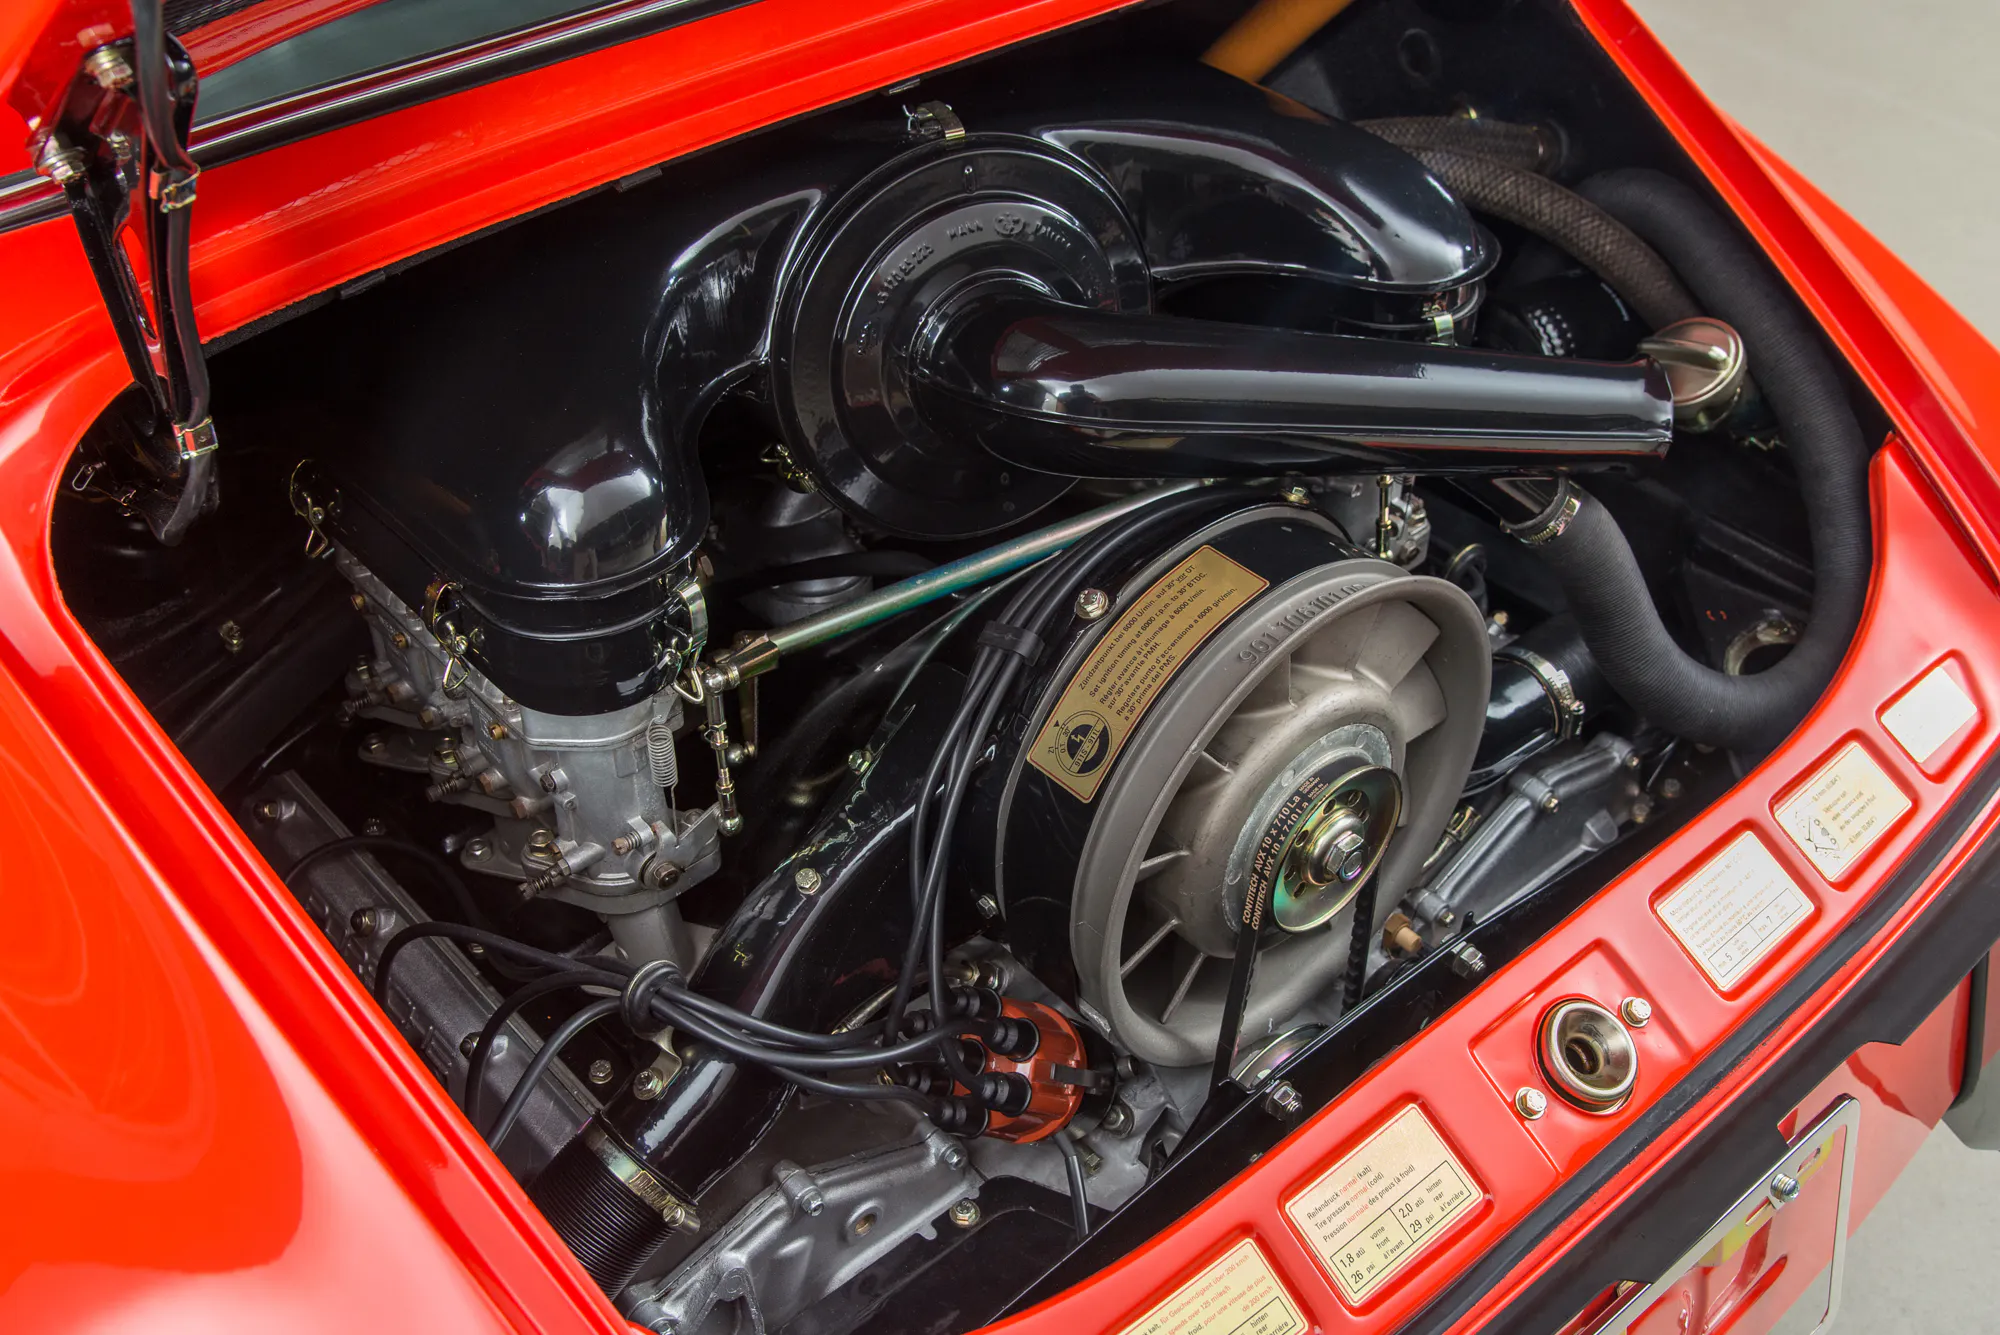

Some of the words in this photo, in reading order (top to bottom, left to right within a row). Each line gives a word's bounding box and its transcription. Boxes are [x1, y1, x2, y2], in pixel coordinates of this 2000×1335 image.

[1079, 643, 1117, 691] Zündzeitpunkt
[1114, 631, 1125, 643] bei
[1123, 616, 1138, 632] 6000
[1156, 588, 1167, 599] auf
[1165, 580, 1175, 590] 30°
[1089, 684, 1101, 698] Set
[1100, 658, 1120, 683] ignition
[1118, 639, 1137, 659] timing
[1135, 630, 1144, 639] at
[1141, 616, 1156, 631] 6000
[1155, 601, 1172, 617] r.p.m.
[1179, 585, 1187, 596] 30°
[1186, 572, 1208, 588] BTDC.
[1100, 681, 1118, 704] Régler
[1117, 655, 1138, 681] avance
[1140, 619, 1170, 652] l'allumage
[1173, 601, 1189, 615] 6000
[1116, 684, 1141, 717] Regolare
[1139, 664, 1157, 685] punto
[1155, 623, 1195, 665] d'accensione
[1197, 605, 1213, 620] 6000
[1212, 587, 1238, 608] giri/min.
[1239, 632, 1280, 665] 901
[1107, 697, 1117, 710] sur
[1115, 683, 1124, 697] 30°
[1124, 665, 1141, 686] avant
[1138, 659, 1146, 667] le
[1143, 642, 1162, 660] PMH.
[1127, 701, 1136, 715] 30°
[1136, 684, 1153, 704] prima
[1151, 671, 1162, 683] del
[1159, 654, 1178, 672] PMS.
[1074, 748, 1088, 767] 911S
[1088, 729, 1101, 744] 911L
[1242, 873, 1260, 924] CONTITECH
[1254, 849, 1267, 873] AVX
[1262, 836, 1272, 849] 10
[1273, 807, 1290, 828] 710
[1286, 795, 1301, 808] La
[1251, 880, 1268, 931] CONTITECH
[1264, 856, 1275, 878] AVX
[1271, 842, 1281, 855] 10
[1282, 813, 1299, 835] 710
[1725, 952, 1733, 961] 5
[1307, 1191, 1341, 1221] Reifendruck
[1339, 1177, 1358, 1196] normal
[1356, 1165, 1372, 1180] (kalt)
[1315, 1218, 1328, 1231] Tire
[1327, 1200, 1351, 1223] pressure
[1350, 1185, 1369, 1203] normal
[1367, 1172, 1385, 1188] (cold)
[1322, 1220, 1348, 1243] Pression
[1347, 1203, 1369, 1225] normale
[1368, 1195, 1379, 1206] des
[1379, 1182, 1396, 1199] pneus
[1399, 1164, 1416, 1181] froid)
[1398, 1202, 1414, 1219] 2,0
[1414, 1197, 1425, 1208] atü
[1426, 1178, 1442, 1194] hinten
[1433, 1191, 1445, 1203] rear
[1376, 1236, 1391, 1249] front
[1409, 1219, 1423, 1233] 29
[1425, 1213, 1435, 1225] psi
[1339, 1253, 1355, 1268] 1,8
[1355, 1247, 1366, 1259] atü
[1370, 1226, 1386, 1240] vorne
[1350, 1270, 1364, 1284] 26
[1366, 1262, 1376, 1274] psi
[1148, 1323, 1162, 1335] kalt,
[1225, 1264, 1236, 1275] 200
[1168, 1318, 1189, 1335] speeds
[1188, 1308, 1201, 1320] over
[1200, 1299, 1212, 1310] 125
[1204, 1313, 1217, 1326] pour
[1217, 1305, 1228, 1315] une
[1228, 1291, 1247, 1306] vitesse
[1247, 1284, 1254, 1292] de
[1254, 1275, 1266, 1287] plus
[1242, 1304, 1250, 1312] de
[1249, 1295, 1260, 1307] 200
[1250, 1312, 1269, 1328] hinten
[1256, 1323, 1268, 1335] rear
